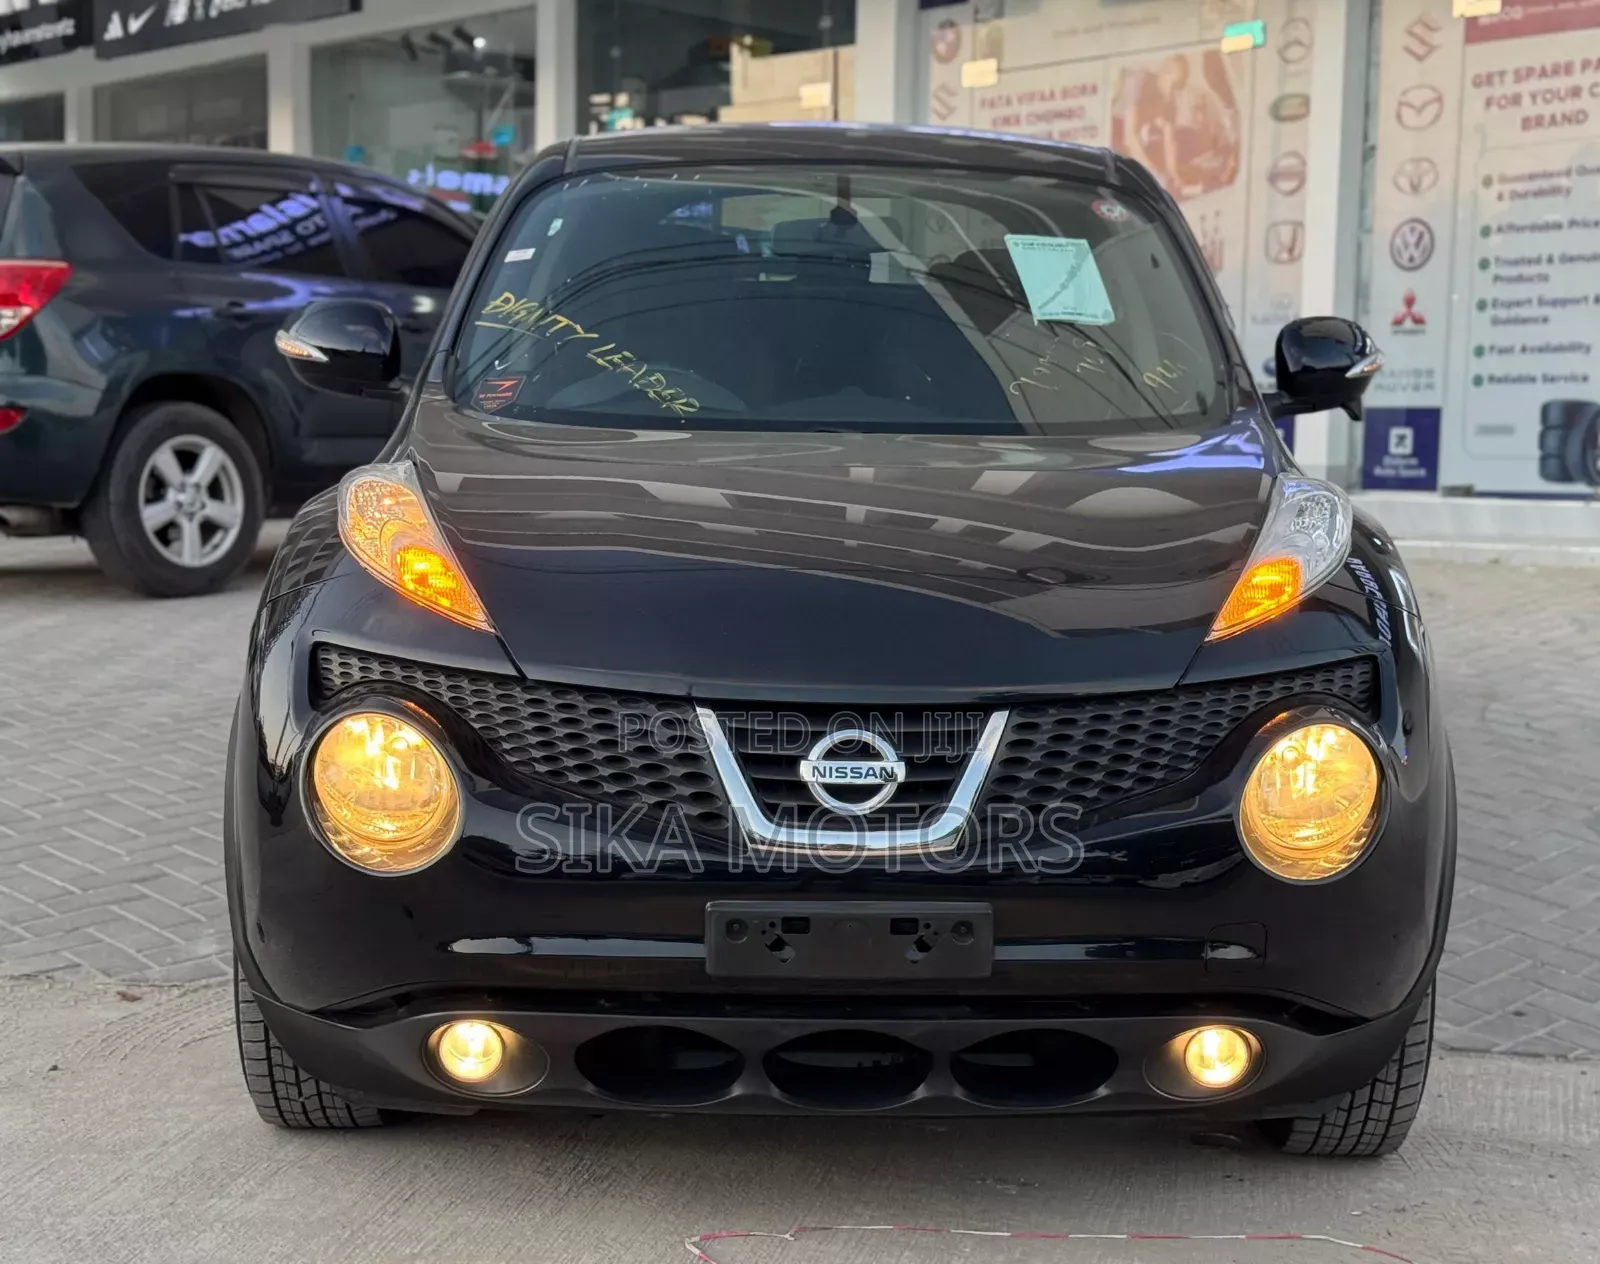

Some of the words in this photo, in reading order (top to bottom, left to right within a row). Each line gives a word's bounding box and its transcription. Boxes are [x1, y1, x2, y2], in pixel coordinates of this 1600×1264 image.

[1471, 69, 1508, 89] GET
[1513, 60, 1576, 84] SPARE
[1484, 92, 1523, 112] FOR
[1528, 84, 1583, 106] YOUR
[1521, 108, 1589, 132] BRAND
[811, 765, 895, 780] NISSAN
